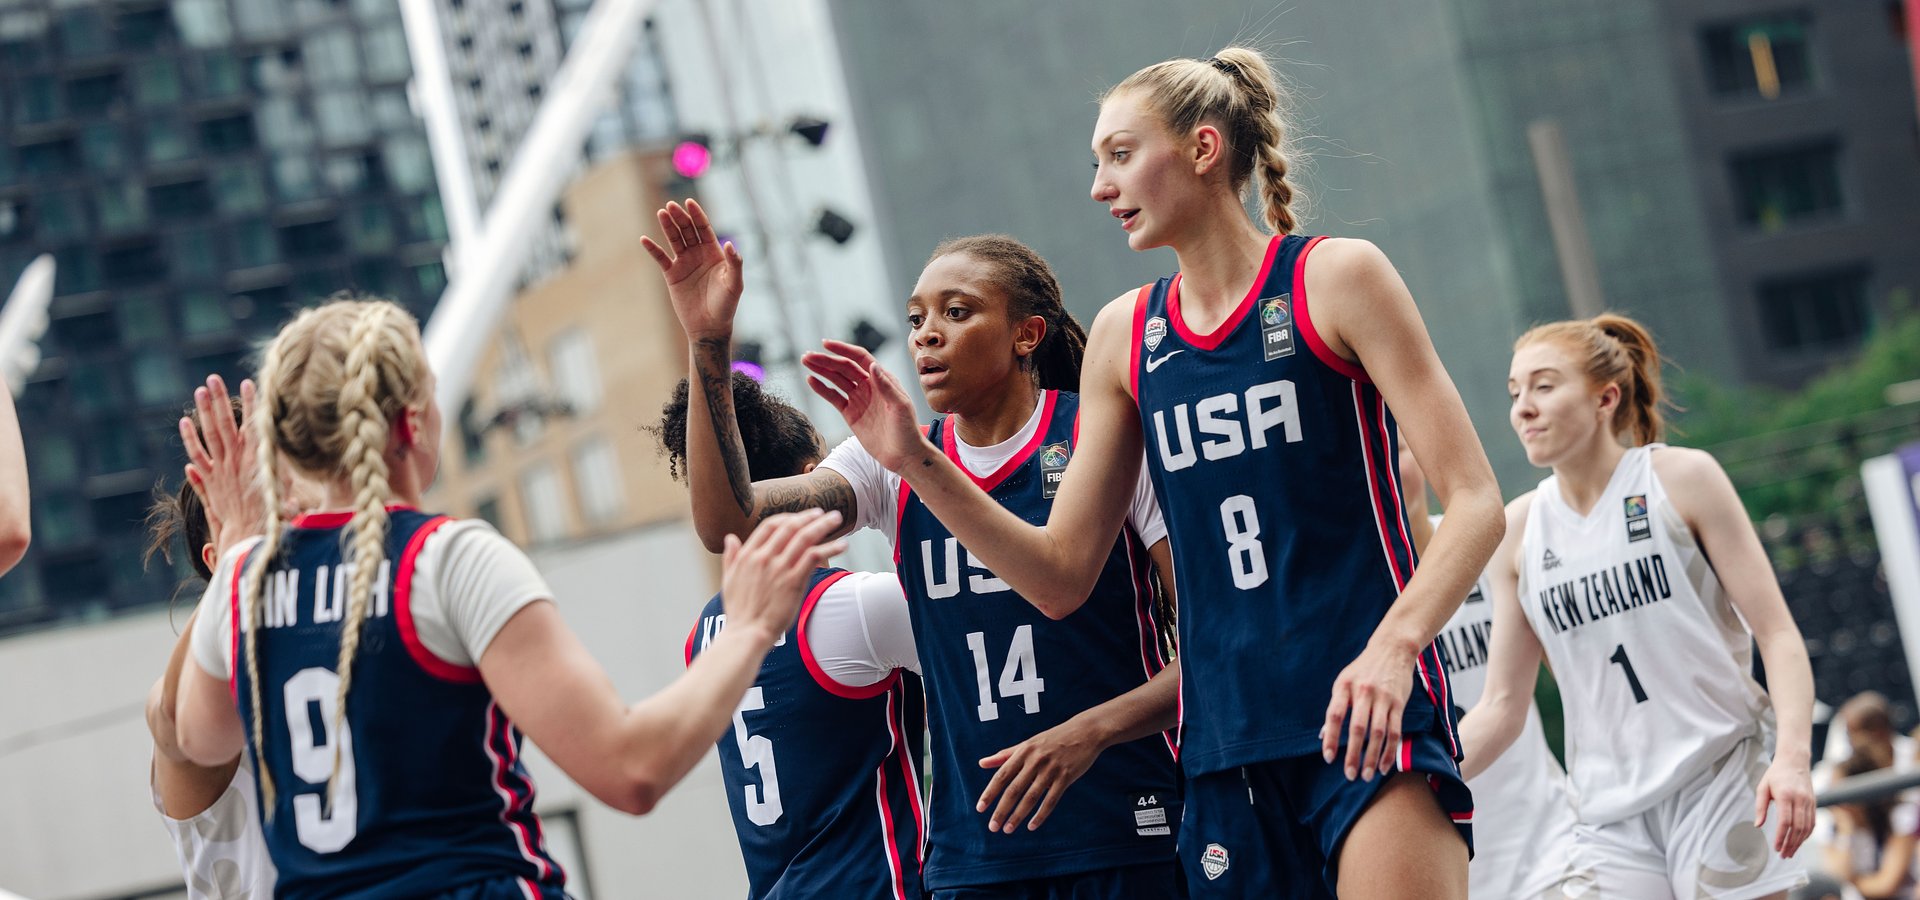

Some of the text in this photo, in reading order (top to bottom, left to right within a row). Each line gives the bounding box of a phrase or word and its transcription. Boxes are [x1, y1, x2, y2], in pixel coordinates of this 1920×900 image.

[1268, 329, 1288, 344] FIBA
[1153, 379, 1303, 473] USA
[921, 526, 1047, 600] US
[1220, 494, 1269, 590] 8
[1540, 554, 1671, 634] NEW ZEALAND
[966, 624, 1045, 722] 14
[1610, 644, 1649, 704] 1
[283, 667, 357, 854] 9
[732, 686, 784, 826] 5
[1137, 795, 1158, 806] 44
[1209, 849, 1225, 860] USA
